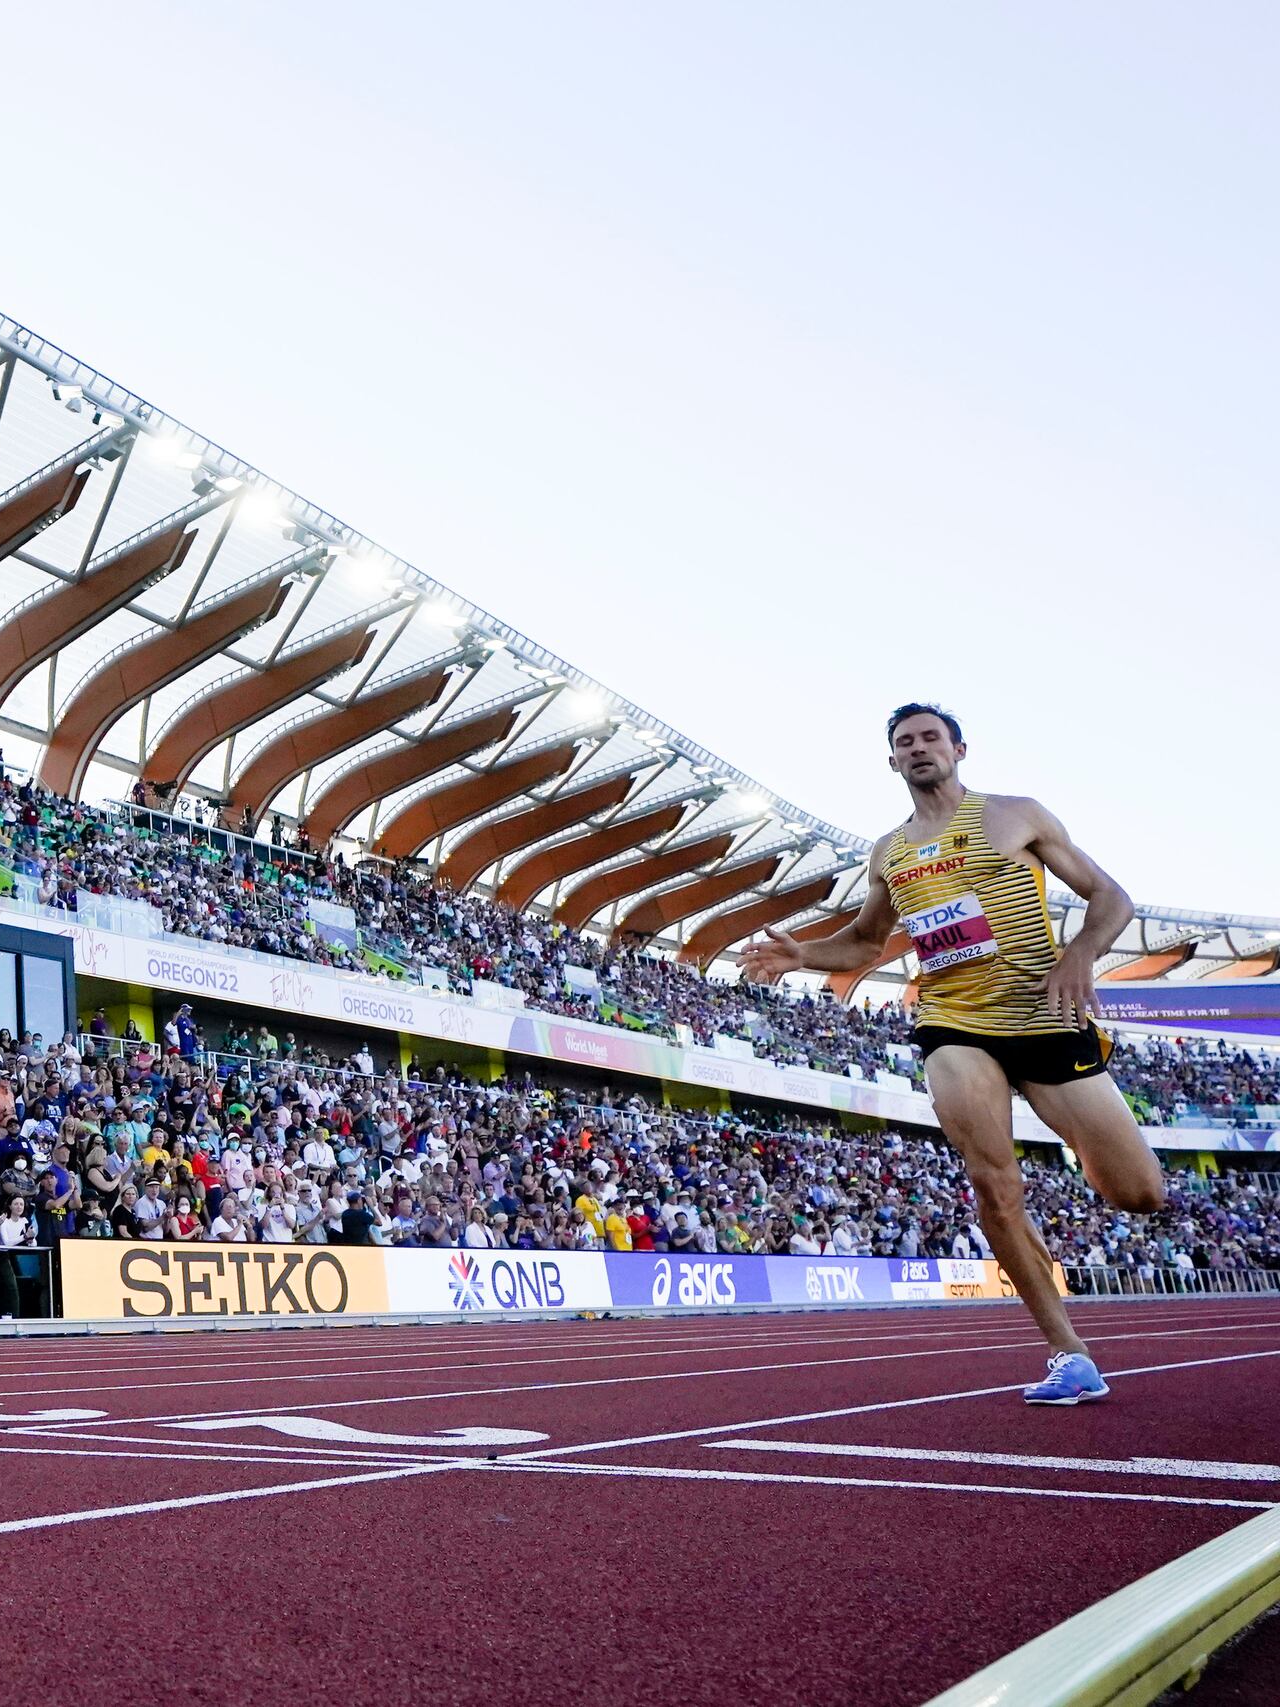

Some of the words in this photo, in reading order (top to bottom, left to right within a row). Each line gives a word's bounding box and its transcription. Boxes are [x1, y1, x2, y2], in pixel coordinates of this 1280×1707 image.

[891, 856, 967, 888] GERMANY
[916, 902, 968, 930] TDK
[916, 925, 972, 954] KAUL
[148, 958, 239, 993] OREGON22
[343, 996, 415, 1025] OREGON22
[120, 1248, 348, 1318] SEIKO
[491, 1259, 566, 1308] QNB
[818, 1266, 864, 1300] TDK
[155, 1416, 551, 1446] 2
